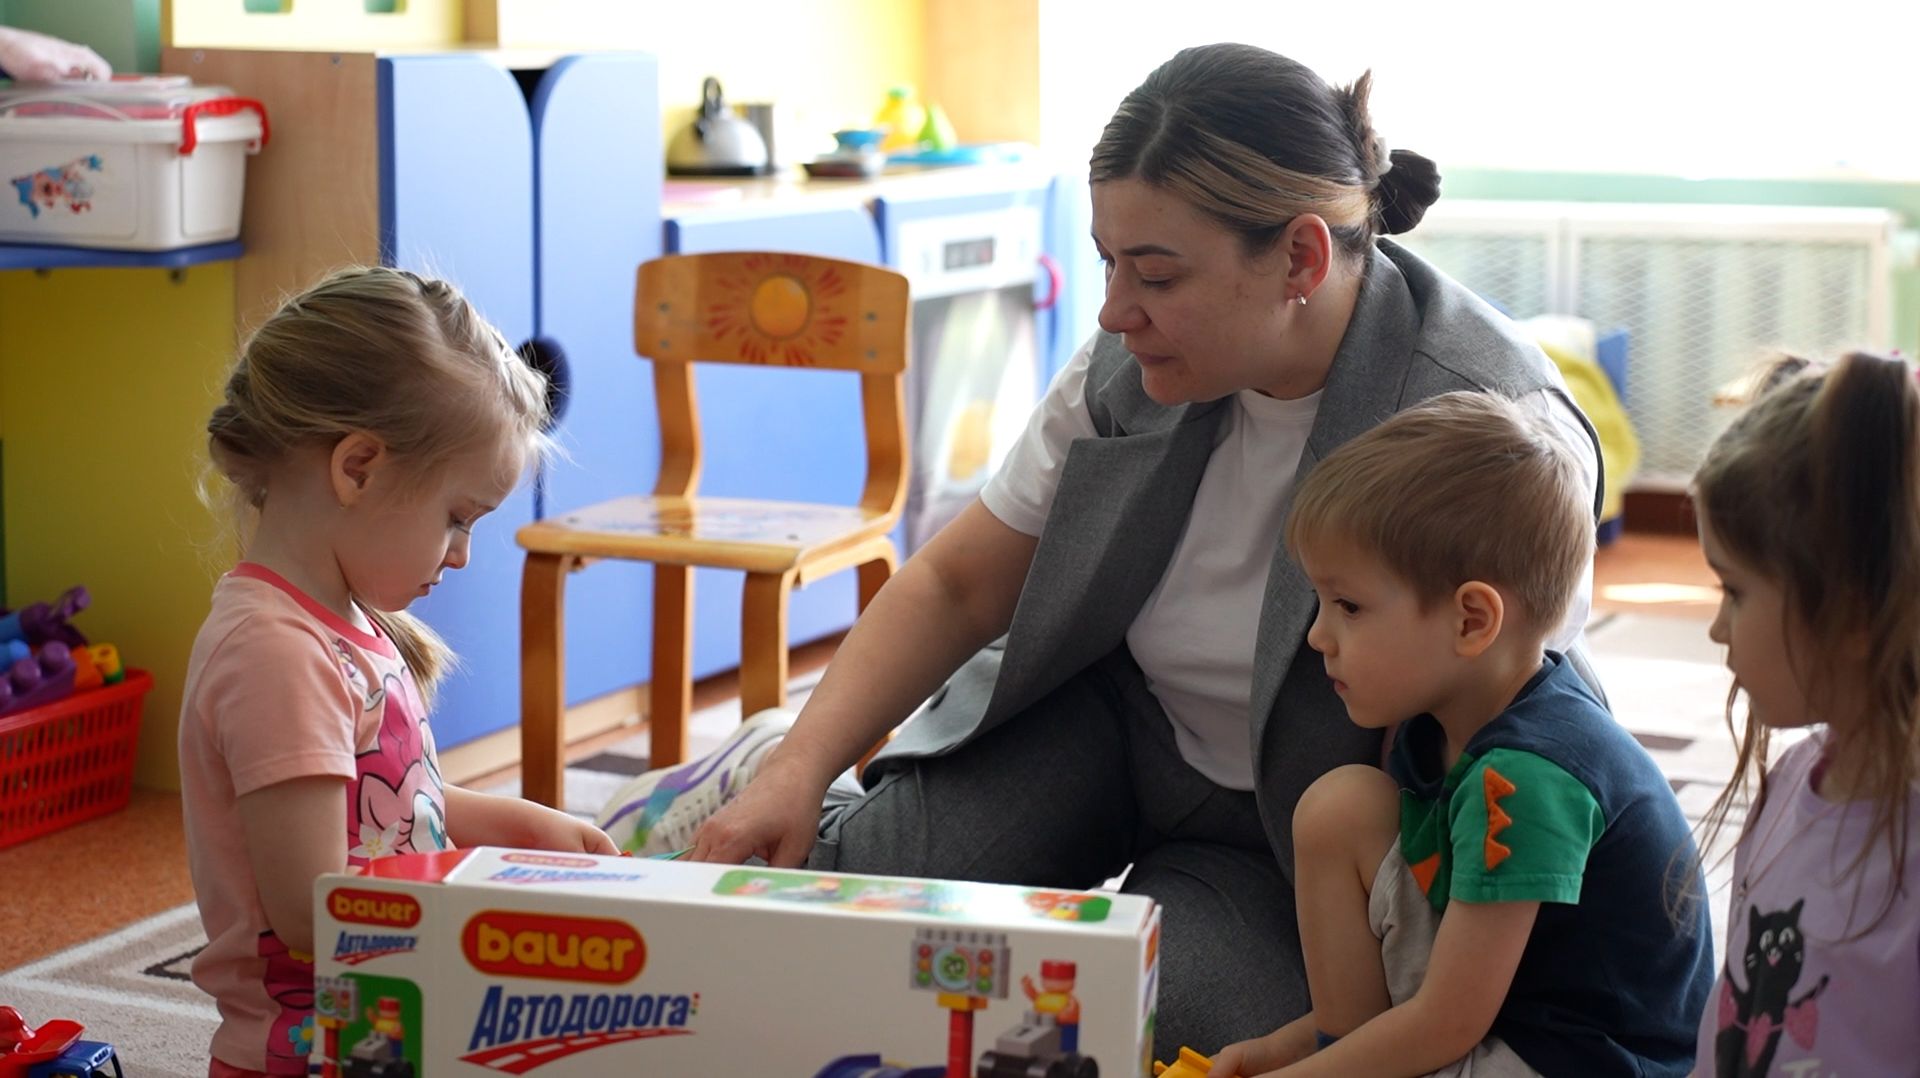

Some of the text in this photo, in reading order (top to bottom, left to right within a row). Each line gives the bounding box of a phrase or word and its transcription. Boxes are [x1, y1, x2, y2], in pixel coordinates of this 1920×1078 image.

[335, 894, 416, 922] bauer
[477, 922, 635, 972] bauer
[467, 985, 690, 1052] Автодорога
